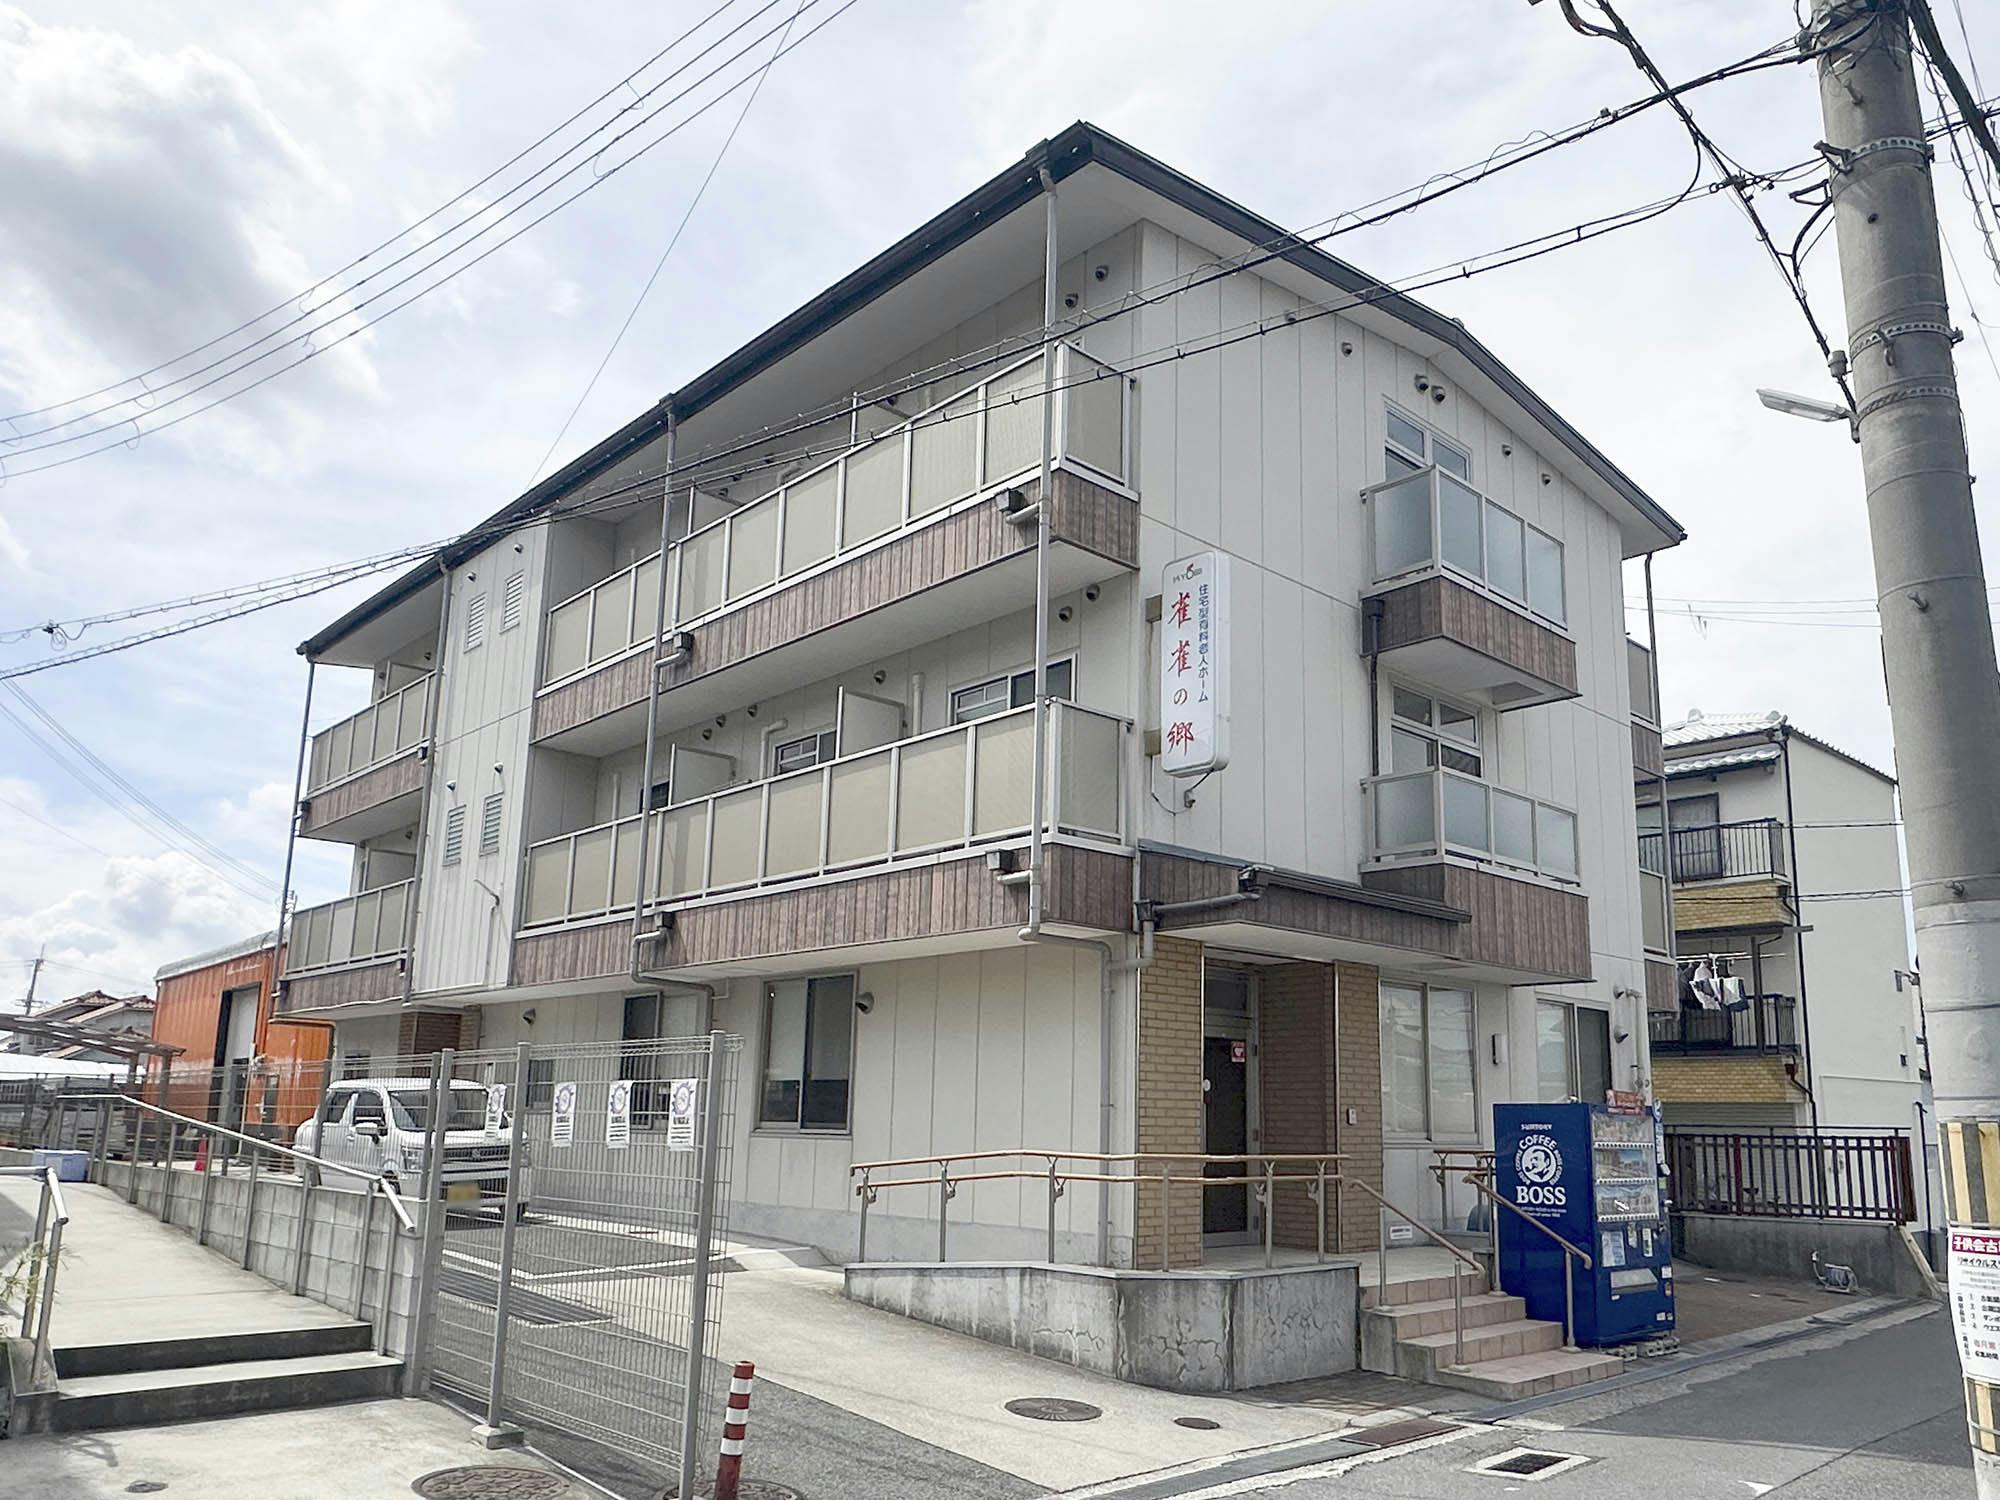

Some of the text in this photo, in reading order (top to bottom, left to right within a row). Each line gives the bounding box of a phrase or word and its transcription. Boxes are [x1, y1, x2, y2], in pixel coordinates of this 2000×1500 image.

[1167, 591, 1195, 757] 雀雀の郷
[1519, 1134, 1558, 1150] COFFEE
[1516, 1185, 1567, 1206] BOSS
[1953, 1236, 2000, 1253] 子供会古
[1957, 1256, 2000, 1269] リサイクルス
